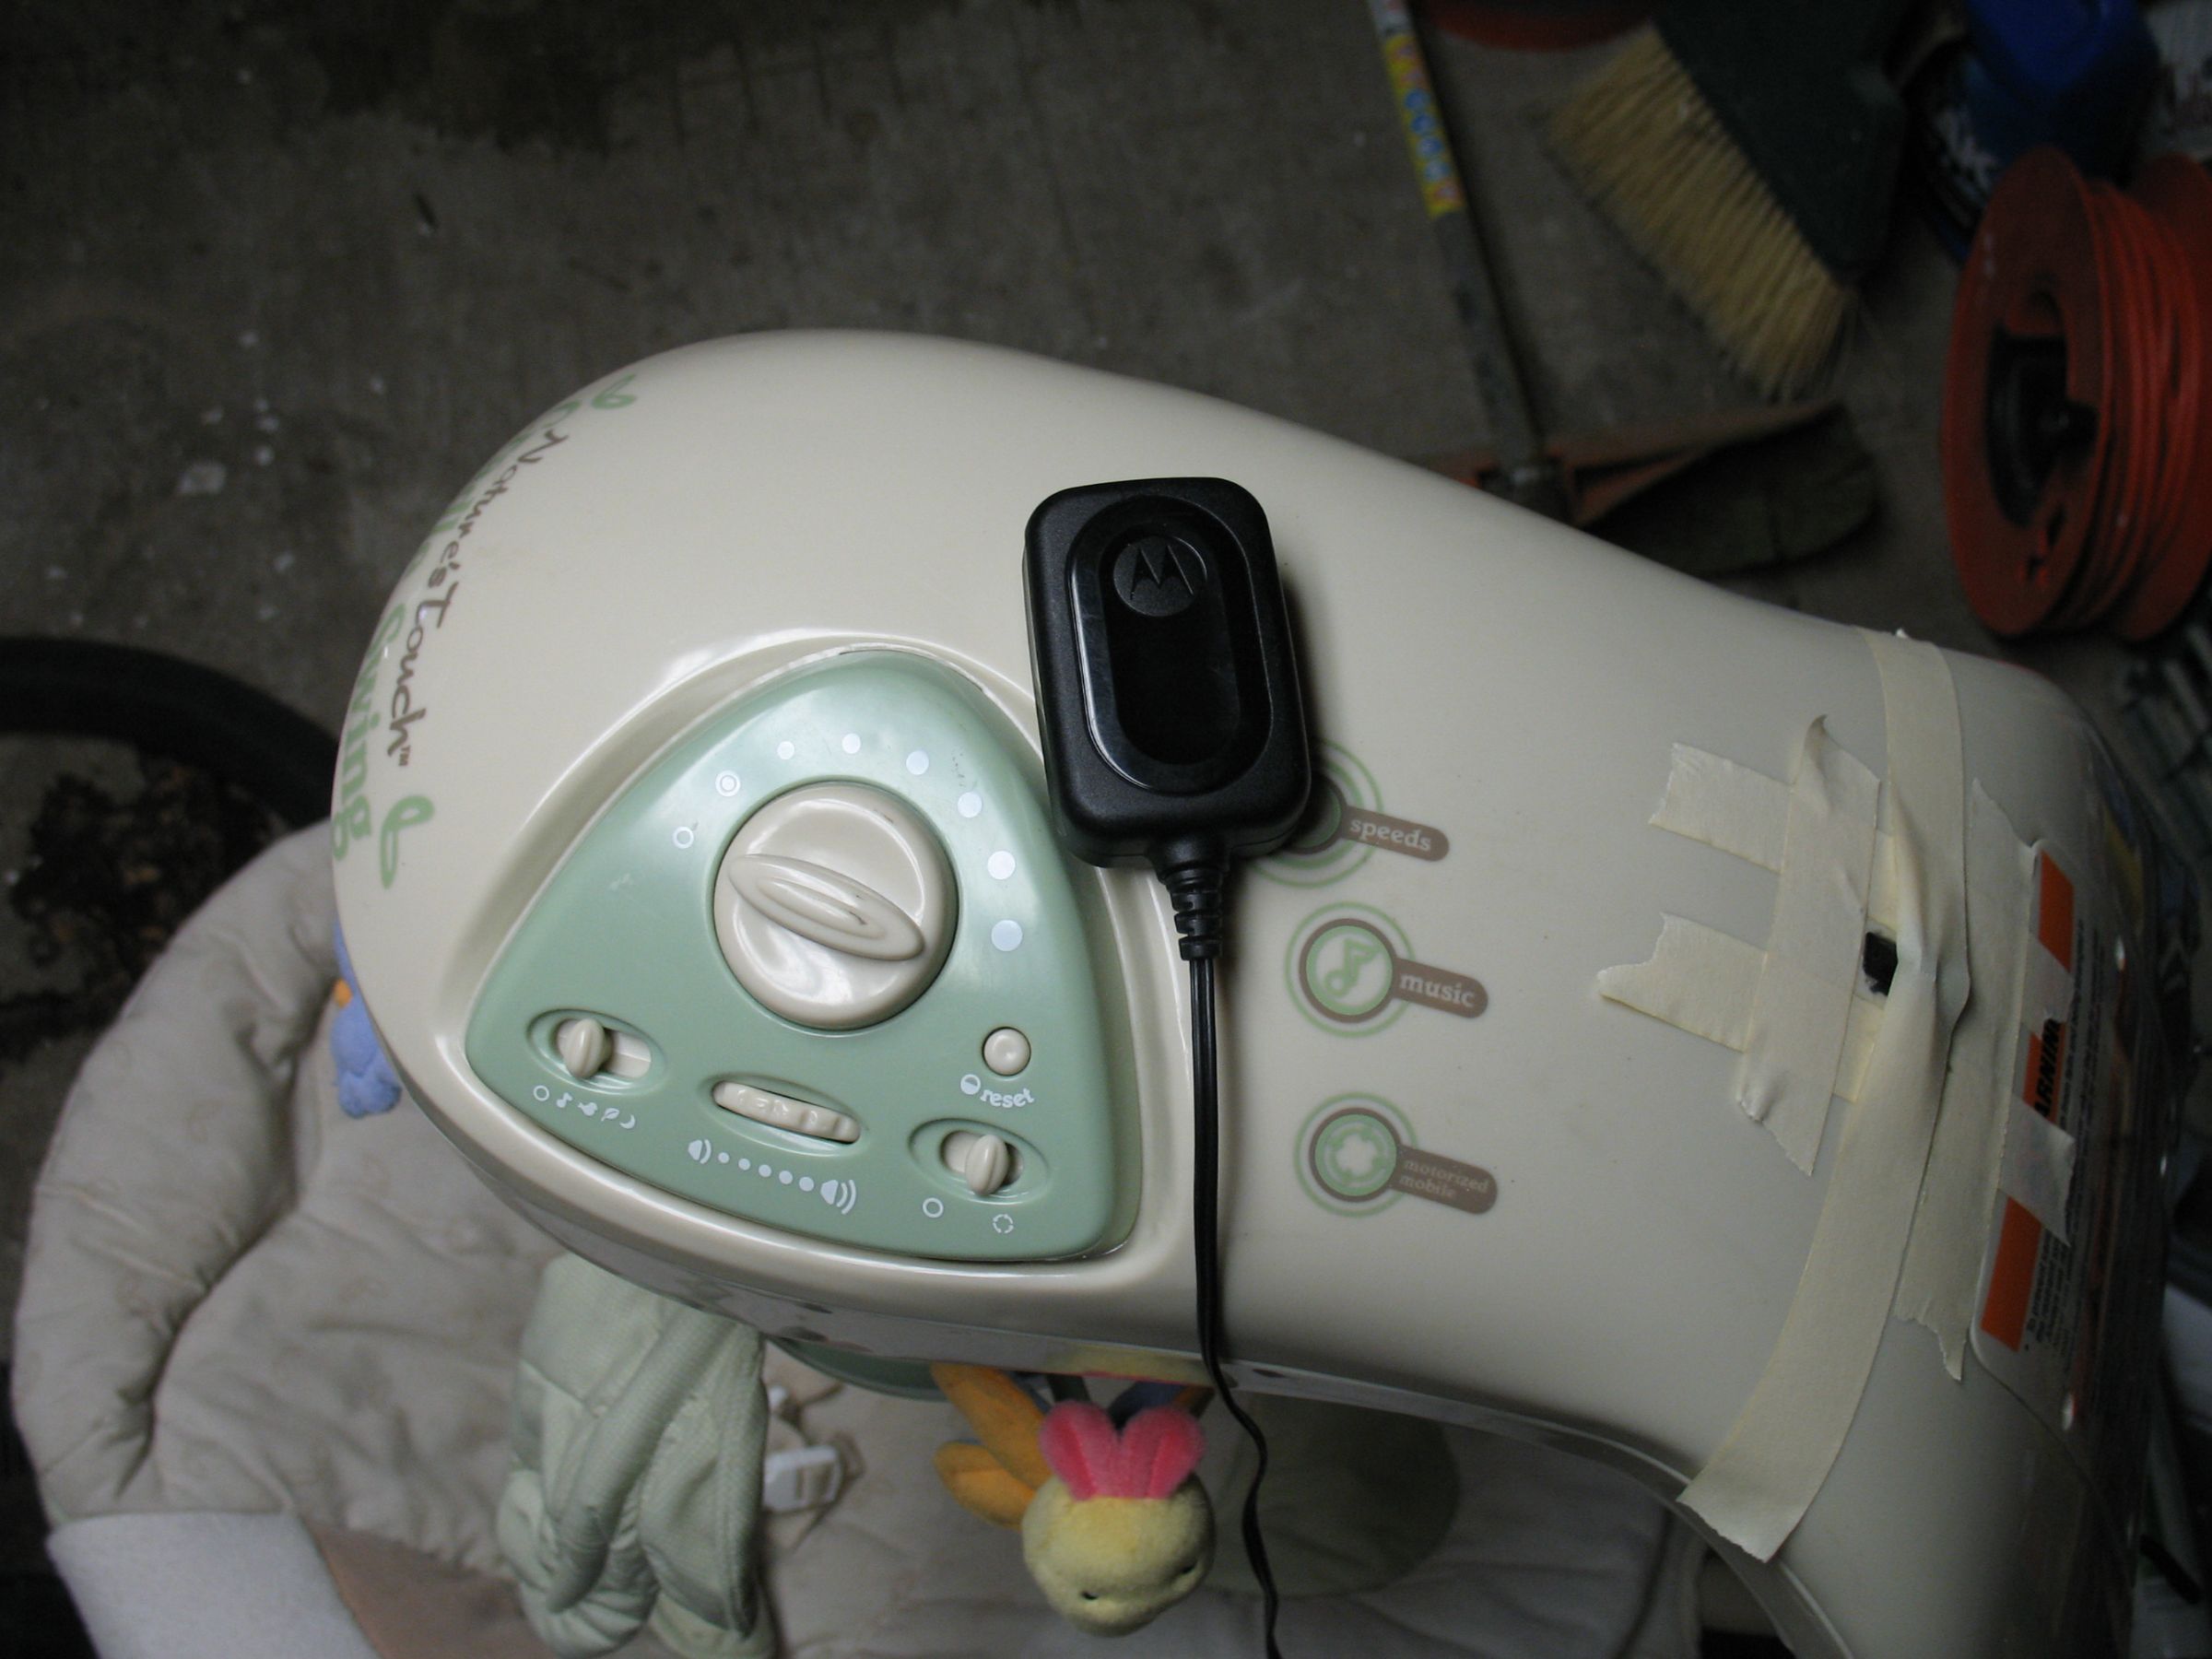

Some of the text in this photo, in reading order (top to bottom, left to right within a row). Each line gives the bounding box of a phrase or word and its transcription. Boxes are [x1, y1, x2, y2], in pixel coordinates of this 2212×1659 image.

[428, 429, 570, 588] Nature's
[1349, 818, 1432, 853] speeds
[1398, 972, 1477, 1009] music
[979, 1087, 1035, 1108] reset
[1403, 1159, 1491, 1195] motorized
